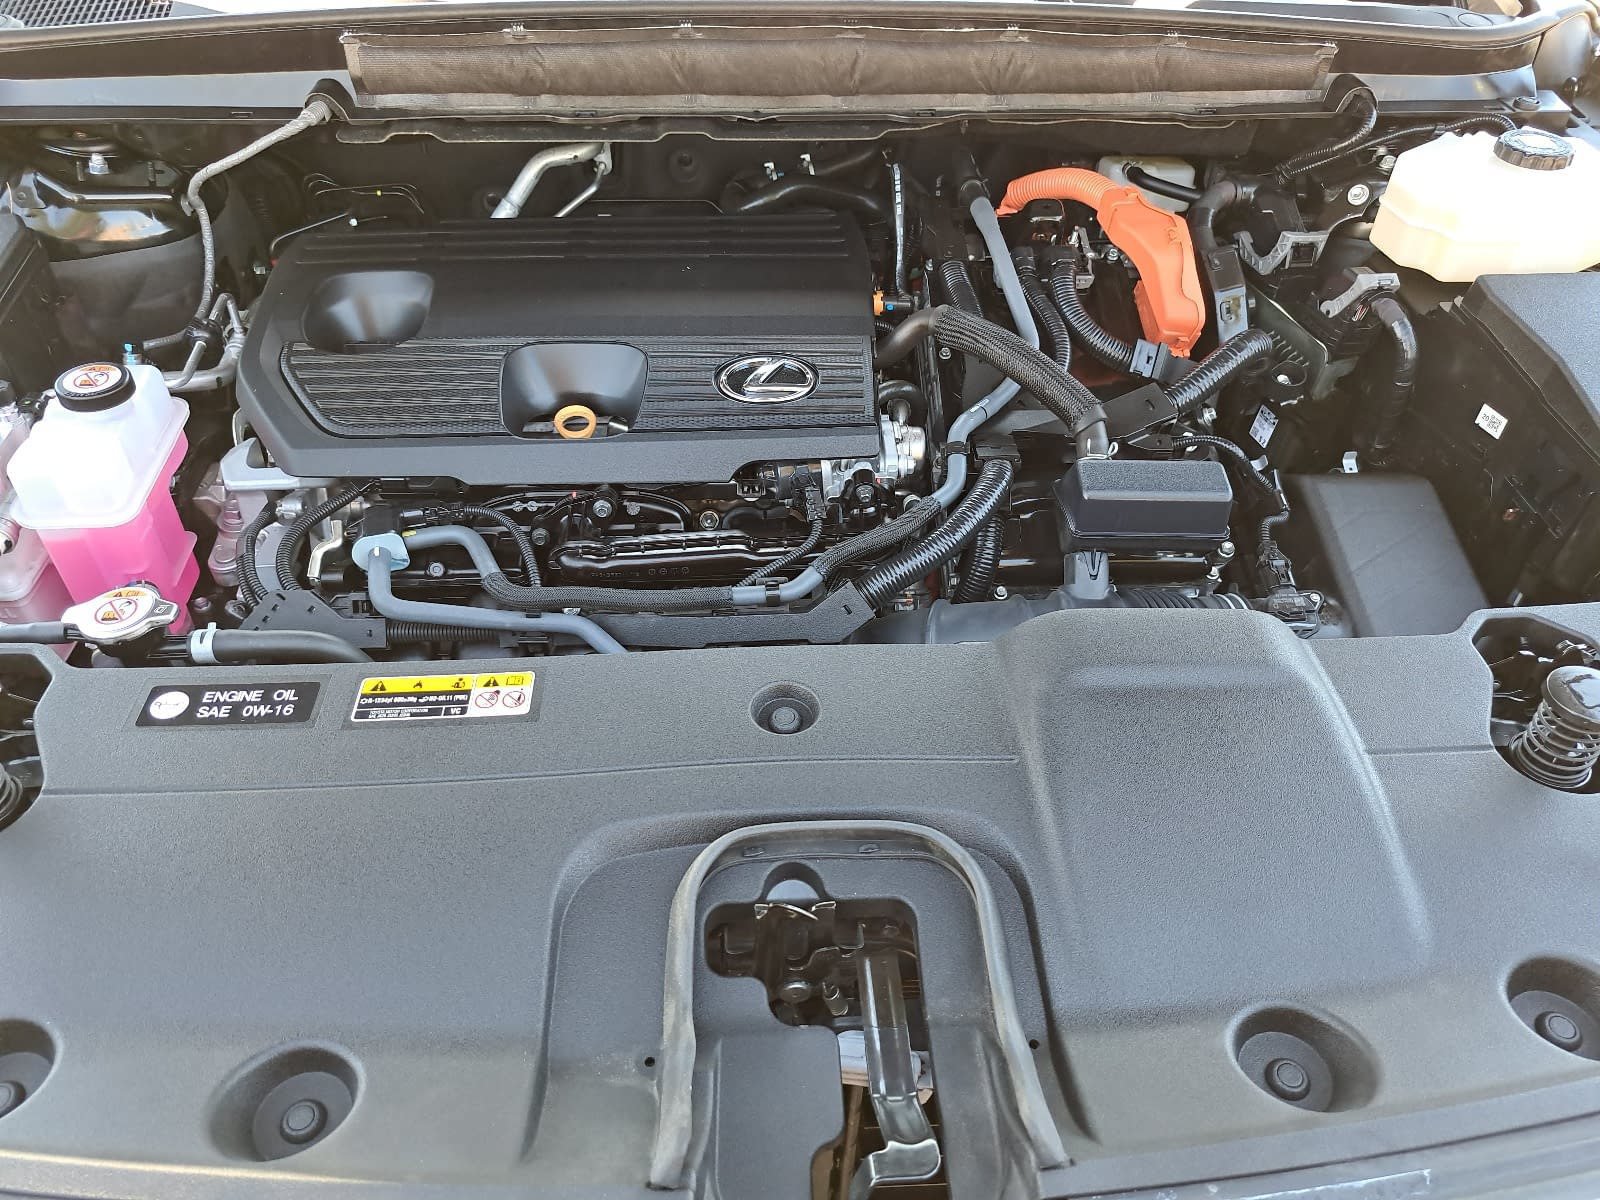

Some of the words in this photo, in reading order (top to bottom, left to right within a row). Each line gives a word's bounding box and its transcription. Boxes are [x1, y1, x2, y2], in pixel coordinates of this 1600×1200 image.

[202, 690, 264, 703] ENGINE
[273, 689, 299, 701] OIL
[196, 705, 233, 718] SAE
[242, 704, 295, 717] 0W-16
[450, 707, 462, 715] VC
